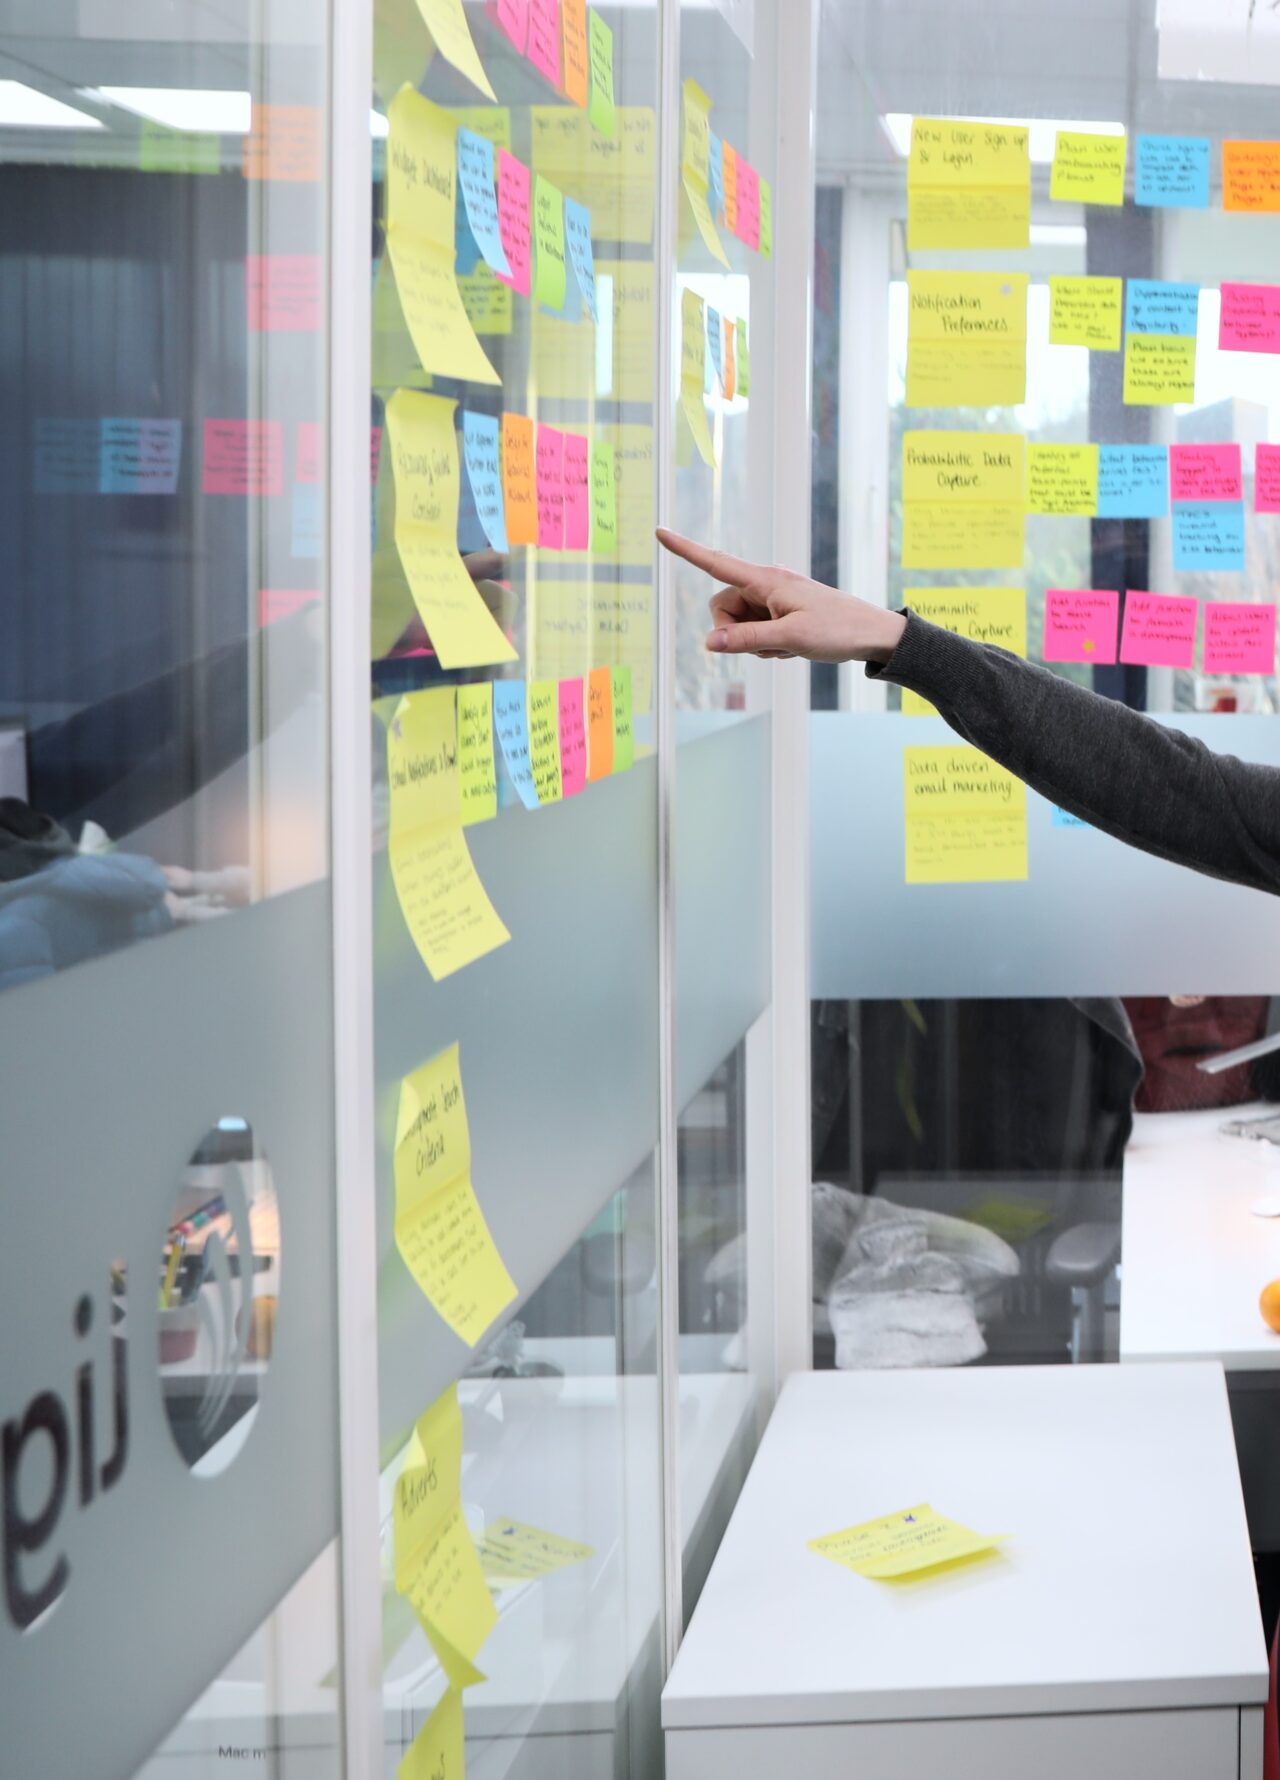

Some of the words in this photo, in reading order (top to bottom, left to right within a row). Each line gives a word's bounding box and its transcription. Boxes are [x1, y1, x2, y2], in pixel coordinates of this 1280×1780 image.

[914, 127, 942, 145] New
[951, 128, 976, 145] User
[983, 129, 1008, 153] Sign
[942, 150, 974, 171] Login
[911, 292, 982, 315] Notification
[941, 314, 1009, 336] Preferences
[936, 471, 982, 492] Capture
[968, 619, 1014, 641] Capture
[908, 757, 940, 775] Data
[946, 754, 990, 775] driven
[914, 778, 948, 795] email
[952, 779, 1013, 802] marketing
[401, 1456, 438, 1520] Adverts
